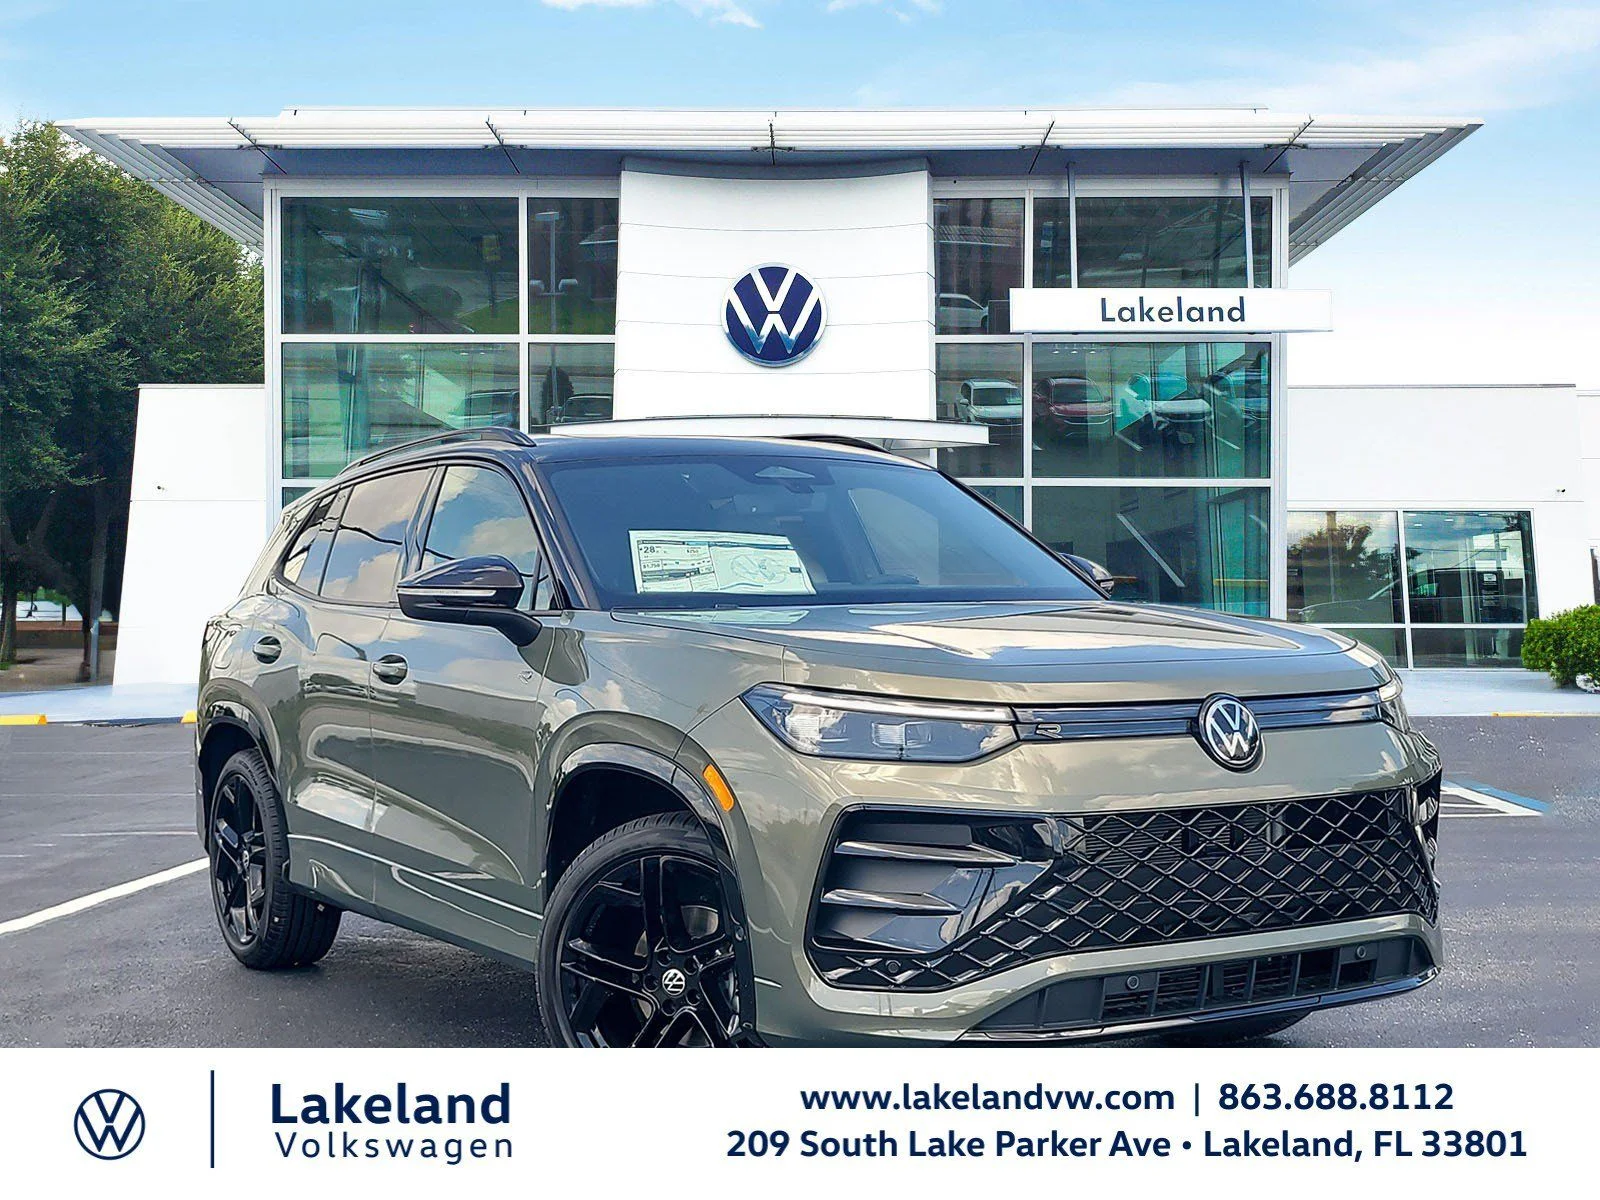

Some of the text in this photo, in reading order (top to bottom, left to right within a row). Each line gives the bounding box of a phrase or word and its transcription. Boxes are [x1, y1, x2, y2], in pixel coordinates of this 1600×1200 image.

[722, 262, 827, 367] VW
[1100, 296, 1246, 322] Lakeland
[643, 546, 655, 554] 28
[1205, 699, 1260, 765] VW
